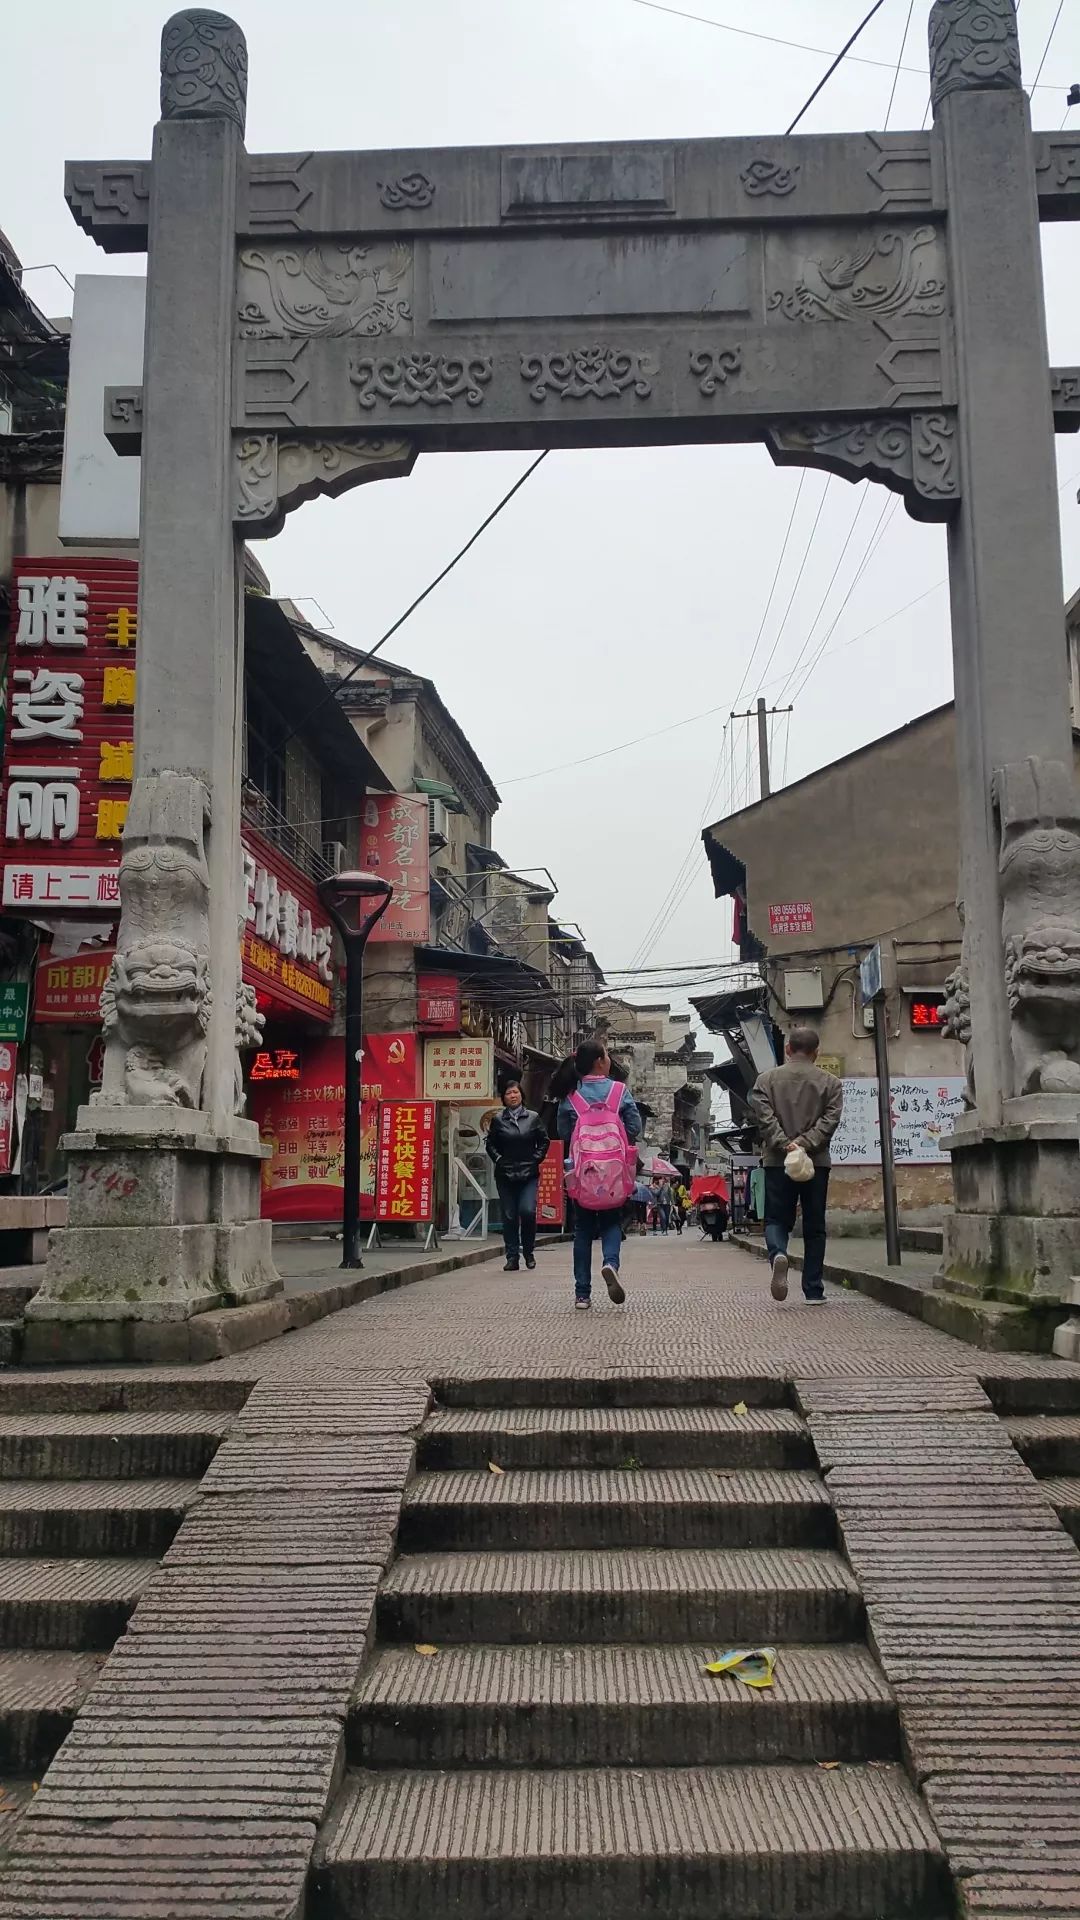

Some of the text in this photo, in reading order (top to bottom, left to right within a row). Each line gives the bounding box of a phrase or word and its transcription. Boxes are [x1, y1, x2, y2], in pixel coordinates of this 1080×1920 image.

[5, 576, 89, 840] 雅姿丽
[384, 802, 421, 912] 成都名小吃
[12, 873, 120, 900] 请上二楼
[251, 1052, 298, 1076] 足疗
[283, 1084, 382, 1101] 社会主义核心值观
[433, 1082, 482, 1090] 小米南瓜粥
[308, 1116, 328, 1130] 民主
[279, 1142, 298, 1154] 自由
[308, 1140, 328, 1153] 平等
[391, 1107, 417, 1216] 江记快餐小吃
[278, 1166, 299, 1180] 爱国
[308, 1165, 329, 1179] 敬业
